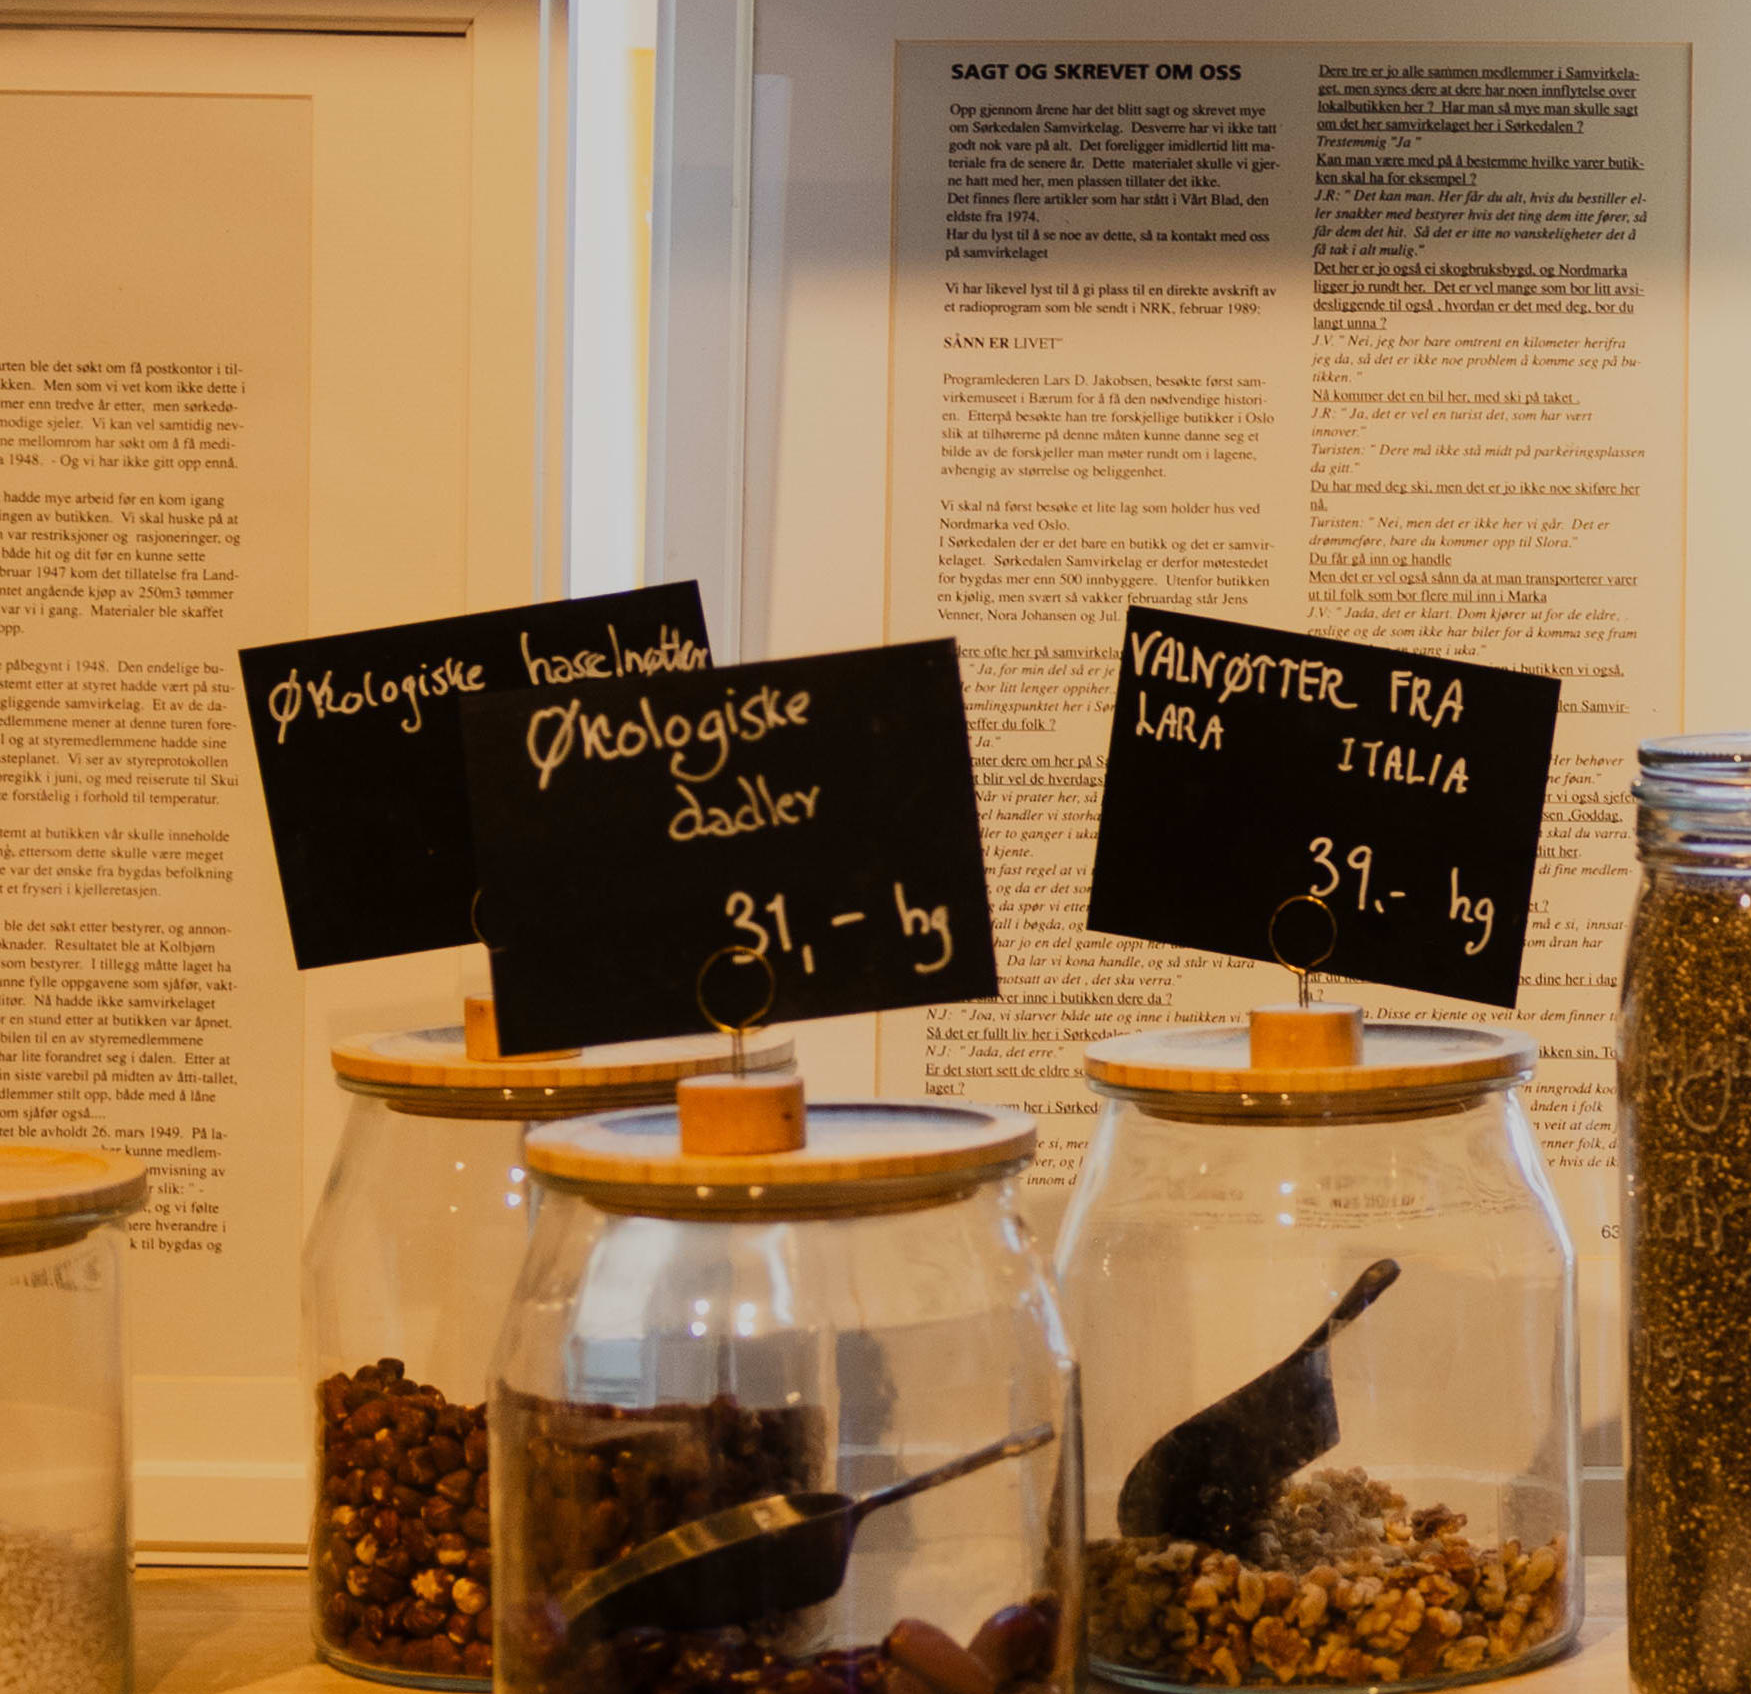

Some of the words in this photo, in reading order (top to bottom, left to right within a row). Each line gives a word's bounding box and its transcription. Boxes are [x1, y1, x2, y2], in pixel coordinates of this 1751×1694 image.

[951, 62, 1010, 81] SAGT
[1014, 62, 1048, 81] OG
[1053, 62, 1150, 81] SKREVET
[1155, 63, 1193, 81] OM
[1199, 63, 1242, 82] OSS
[949, 102, 977, 120] Opp
[979, 103, 1033, 120] gjennom
[1035, 103, 1069, 117] årene
[1071, 103, 1093, 117] har
[1094, 102, 1114, 117] det
[1117, 102, 1142, 117] blitt
[1145, 104, 1171, 120] sagt
[1172, 105, 1189, 120] og
[1191, 102, 1237, 117] skrevet
[1239, 105, 1267, 120] mye
[945, 209, 983, 223] eldste
[985, 209, 1003, 223] fra
[1007, 210, 1040, 223] 1974.
[943, 332, 985, 350] SÅNN
[988, 336, 1010, 350] ER
[943, 372, 1040, 390] Programlederen
[1043, 373, 1071, 387] Lars
[1073, 373, 1089, 387] D.
[1092, 372, 1152, 388] Jakobsen,
[1155, 374, 1202, 388] besøkte
[1205, 374, 1233, 388] først
[1237, 377, 1266, 388] sam-
[28, 400, 52, 411] enn
[55, 397, 95, 412] tredve
[97, 397, 112, 411] år
[113, 401, 145, 414] etter,
[152, 401, 180, 413] men
[183, 398, 238, 414] sørkedø-
[1308, 533, 1386, 550] drømmeføre,
[1389, 534, 1418, 547] bare
[1419, 534, 1436, 547] du
[1439, 533, 1489, 548] kommer
[1492, 538, 1516, 552] opp
[1518, 534, 1533, 549] til
[267, 657, 487, 745] Økologiske
[519, 622, 710, 687] haselnøtter
[1130, 629, 1358, 711] VALNØTTER
[1389, 669, 1465, 729] FRA
[526, 683, 813, 791] Økologiske
[1135, 689, 1225, 751] LARA
[1337, 736, 1470, 795] ITALIA
[667, 773, 821, 842] dadler
[1448, 866, 1495, 956] hg
[892, 880, 954, 975] hg
[18, 1124, 37, 1138] ble
[40, 1123, 87, 1139] avholdt
[91, 1124, 111, 1139] 26.
[114, 1128, 145, 1139] mars
[150, 1125, 183, 1140] 1949.
[191, 1126, 208, 1141] På
[211, 1127, 227, 1141] la-
[1601, 1224, 1621, 1240] 63
